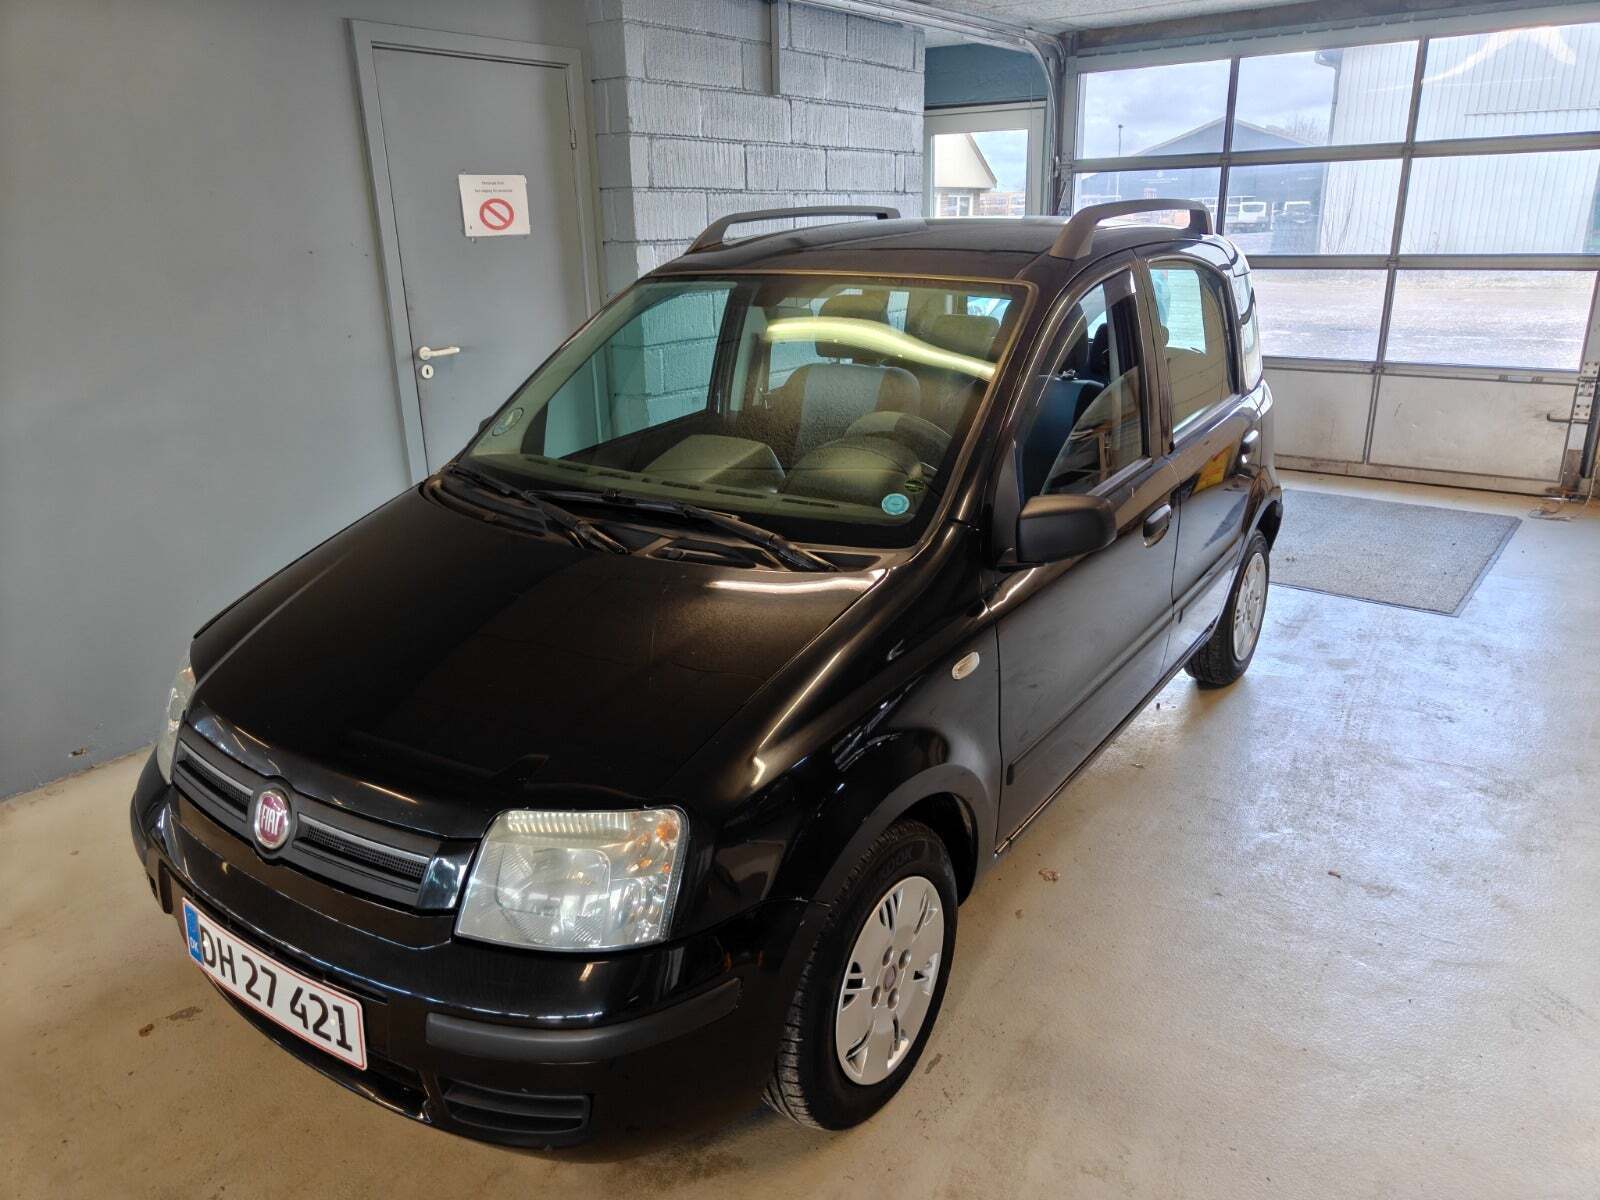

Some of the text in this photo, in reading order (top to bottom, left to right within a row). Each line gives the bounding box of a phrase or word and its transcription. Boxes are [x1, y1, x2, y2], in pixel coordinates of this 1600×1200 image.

[261, 804, 287, 836] FIAT
[200, 924, 352, 1052] DH 27 421
